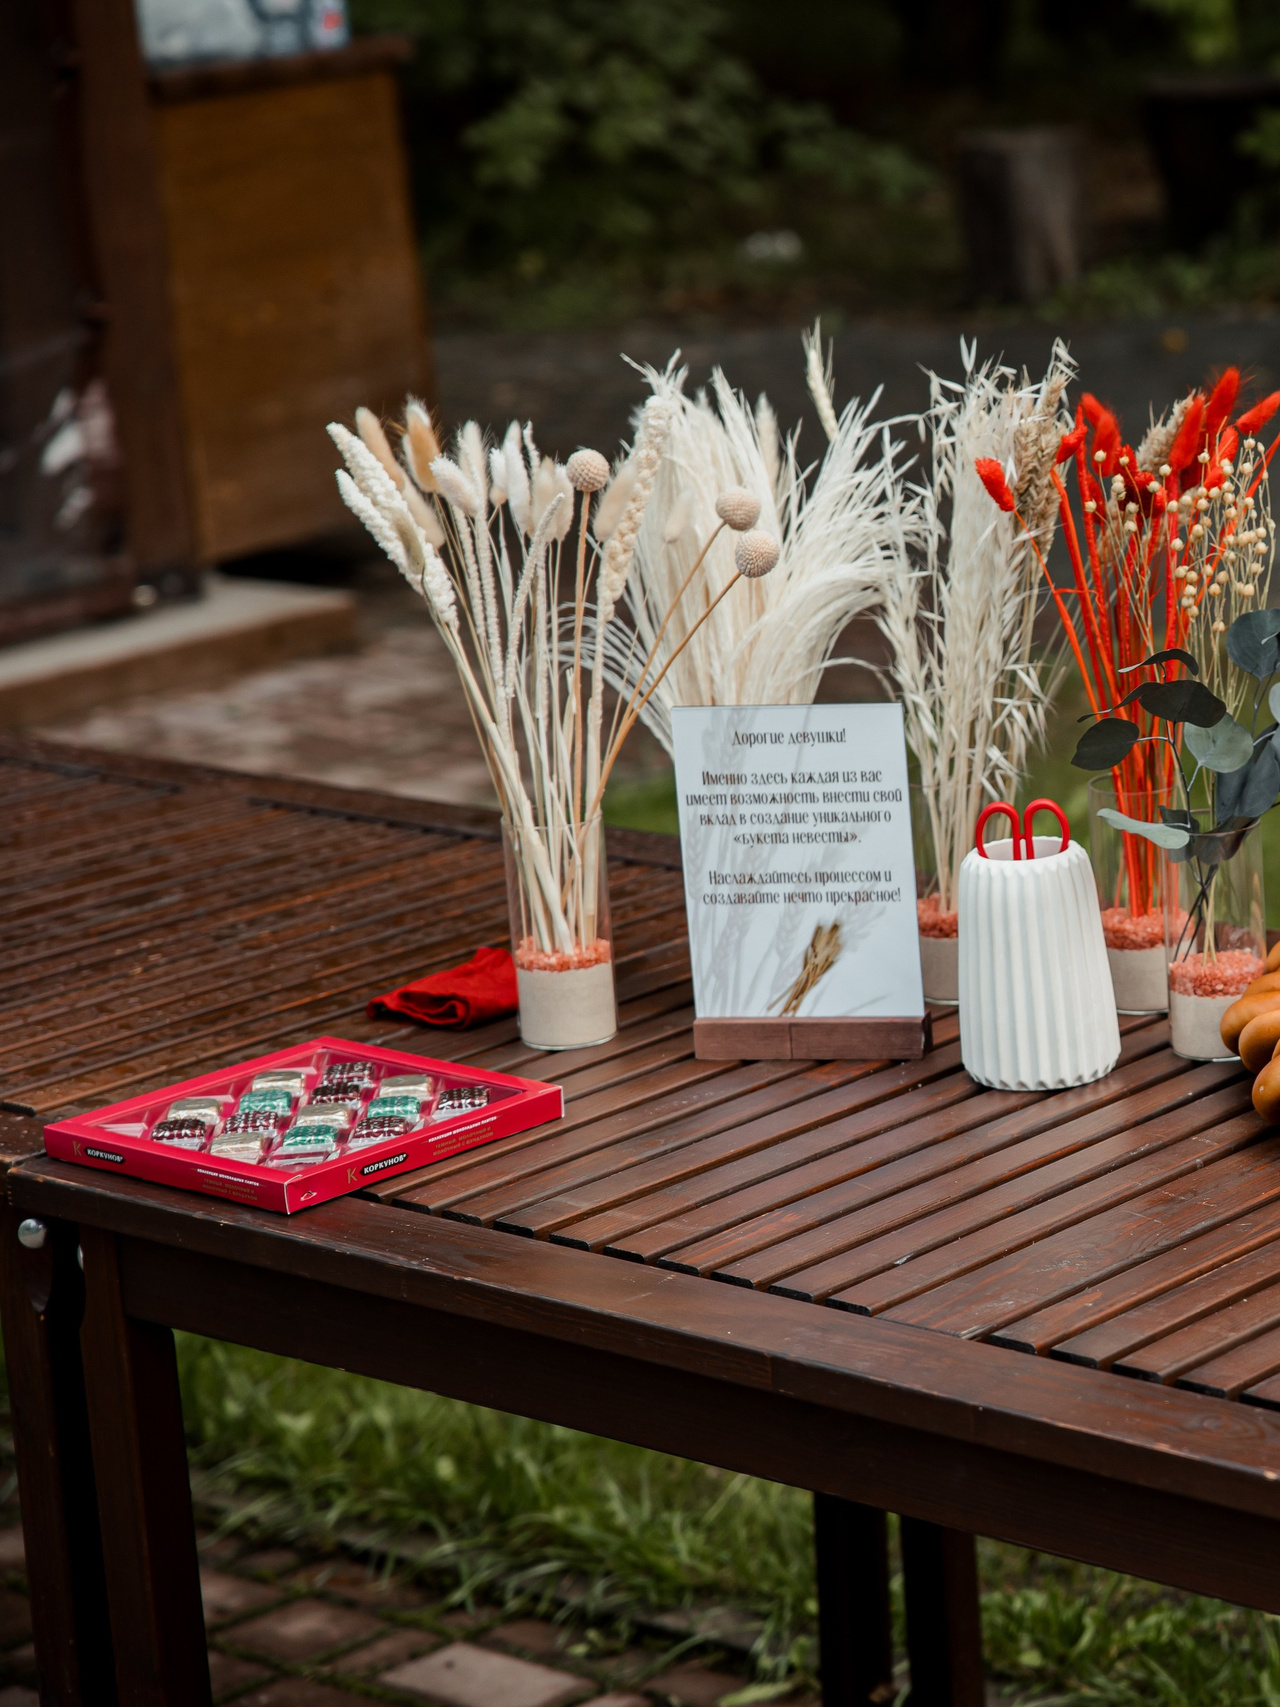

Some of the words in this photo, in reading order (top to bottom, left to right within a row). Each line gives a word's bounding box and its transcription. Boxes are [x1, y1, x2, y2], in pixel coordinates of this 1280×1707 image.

[732, 731, 784, 747] Дорогие
[788, 729, 846, 746] девушки!
[702, 771, 747, 785] Именно
[751, 772, 787, 785] здесь
[791, 771, 839, 785] каждая
[842, 771, 858, 783] из
[861, 770, 882, 782] вас
[686, 793, 727, 806] имеет
[730, 791, 819, 806] возможность
[823, 790, 870, 803] внести
[873, 788, 902, 802] свой
[700, 812, 736, 826] вклад
[739, 813, 747, 824] в
[750, 811, 809, 826] создание
[812, 809, 891, 827] уникального
[793, 830, 861, 844] невесты».
[709, 871, 811, 885] Наслаждайтесь
[815, 870, 881, 886] процессом
[884, 870, 892, 882] и
[703, 891, 780, 905] создавайте
[784, 890, 822, 903] нечто
[826, 888, 901, 906] прекрасное!
